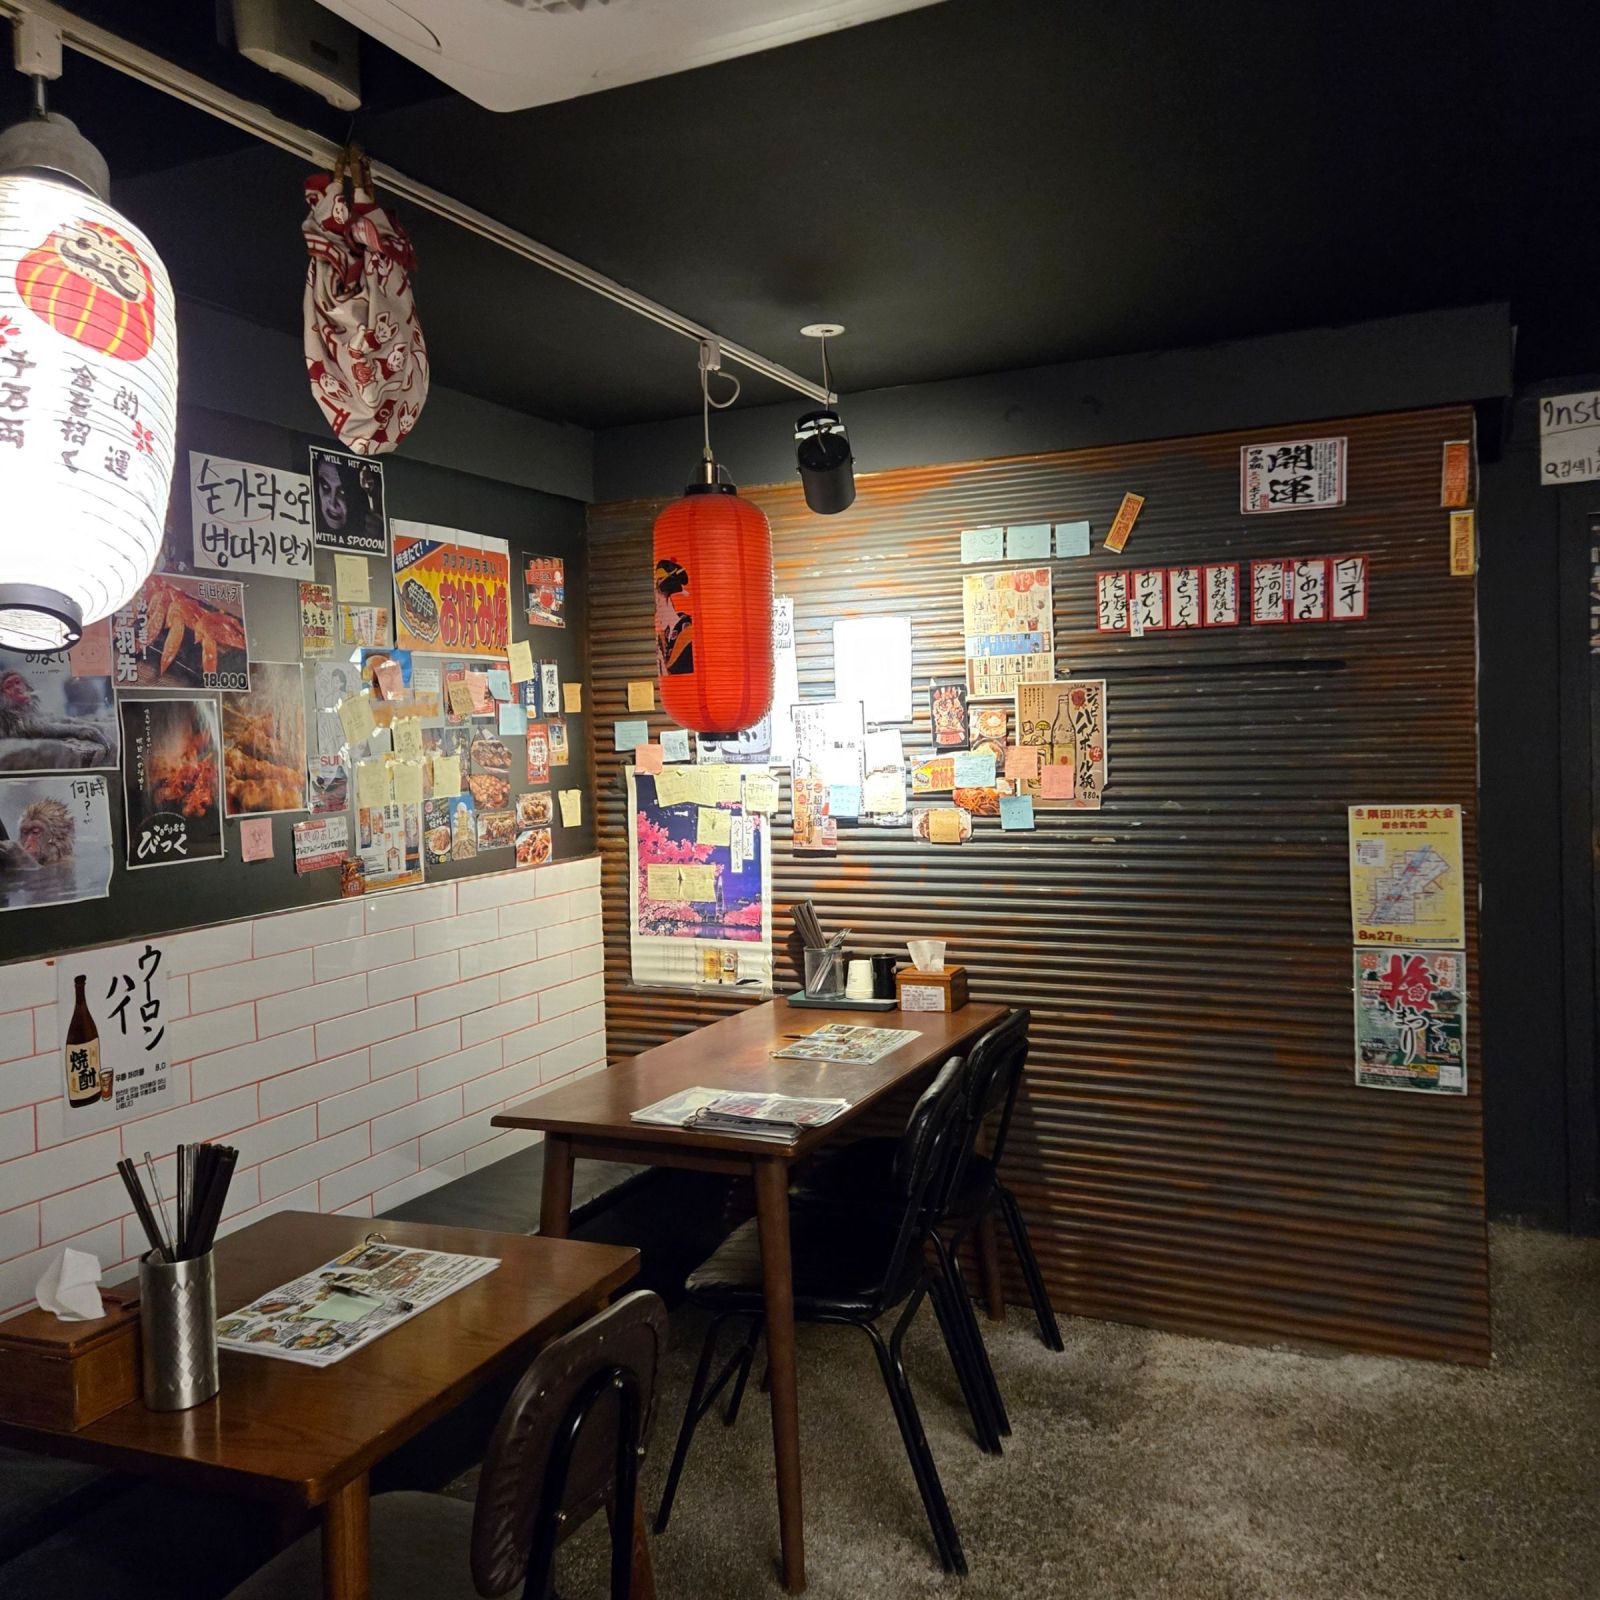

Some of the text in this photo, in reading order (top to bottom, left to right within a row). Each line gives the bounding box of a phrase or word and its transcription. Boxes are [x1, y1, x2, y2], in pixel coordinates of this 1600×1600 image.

[323, 454, 342, 465] WILL
[315, 532, 337, 543] WITH
[338, 536, 345, 544] A
[1141, 570, 1161, 627] おでん
[203, 672, 247, 688] 18.000
[106, 974, 136, 1035] ハイ
[138, 944, 165, 1051] ウーロン
[70, 1049, 97, 1091] 焼酎
